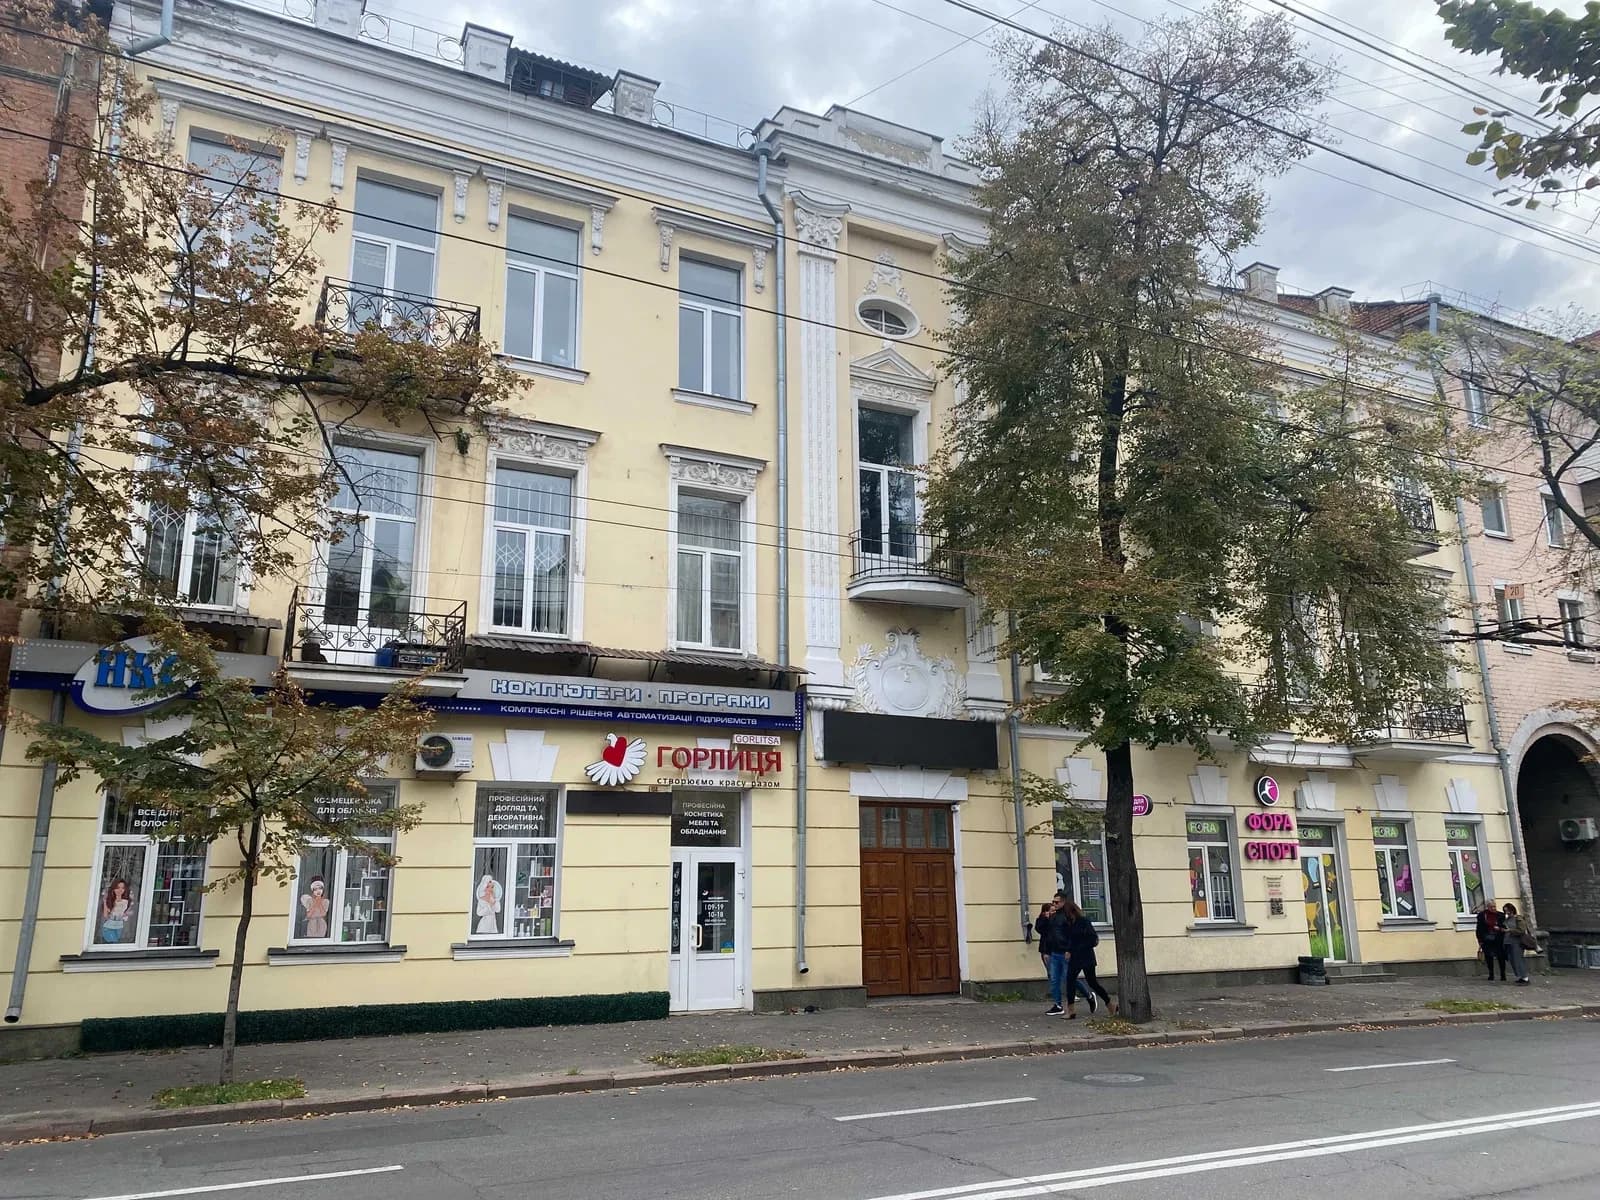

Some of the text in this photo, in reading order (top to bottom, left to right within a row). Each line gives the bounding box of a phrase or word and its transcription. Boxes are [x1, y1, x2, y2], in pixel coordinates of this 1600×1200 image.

[1510, 586, 1519, 596] 20
[491, 678, 771, 709] КОМП'ЮТЕРИ ПРОГРАМИ
[500, 705, 566, 715] КОМПЛЕКСНІ
[570, 709, 613, 717] РІШЕННЯ
[617, 711, 692, 722] АВТОМАТИЗАЦІЇ
[735, 735, 780, 745] GORLITSA
[657, 746, 782, 777] ГОРЛИЦЯ
[657, 778, 714, 787] створюємо
[719, 780, 745, 788] красу
[488, 794, 545, 803] ПРОФЕСІЙНИЙ
[494, 804, 526, 812] ДОГЛЯД
[492, 823, 539, 831] КОСМЕТИКА
[1245, 813, 1293, 831] ФОРА
[1245, 842, 1300, 860] СПОРТ
